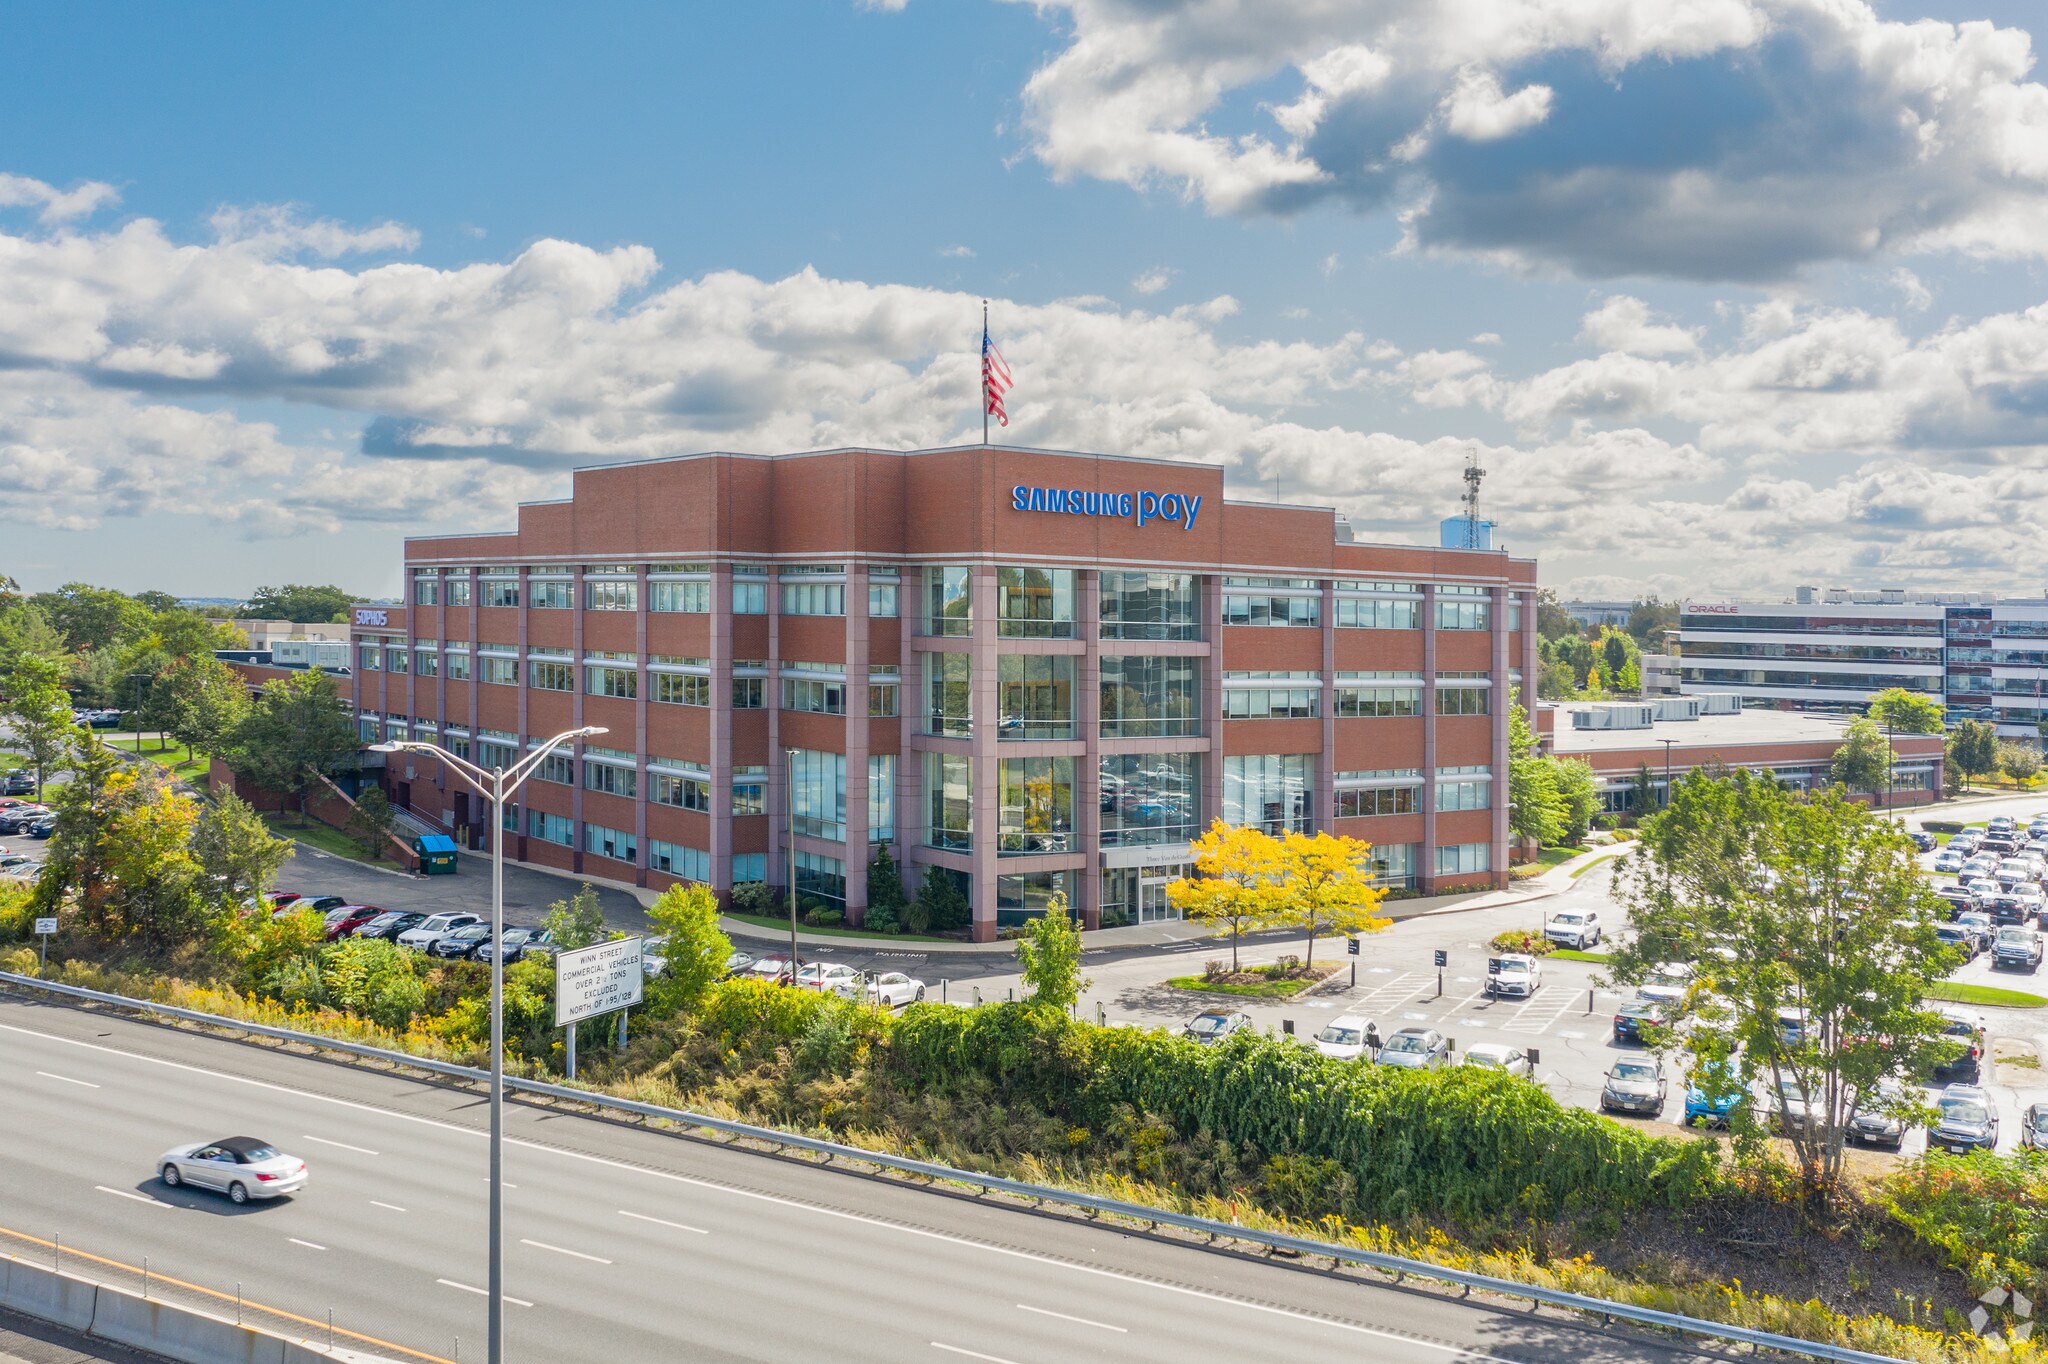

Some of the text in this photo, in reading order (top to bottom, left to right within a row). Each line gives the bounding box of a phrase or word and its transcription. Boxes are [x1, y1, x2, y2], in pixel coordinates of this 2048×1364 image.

[1012, 485, 1203, 531] SAMSUNG pay
[355, 609, 388, 626] SOPHOS
[1688, 605, 1739, 614] ORACLE
[580, 947, 623, 964] WINN STREET
[562, 955, 639, 981] COMMERCIAL VEHICLES
[575, 976, 593, 990] OVER
[610, 969, 627, 981] TONS
[584, 983, 619, 1000] EXCLUDED
[569, 1003, 592, 1016] NORTH
[594, 999, 603, 1009] OF
